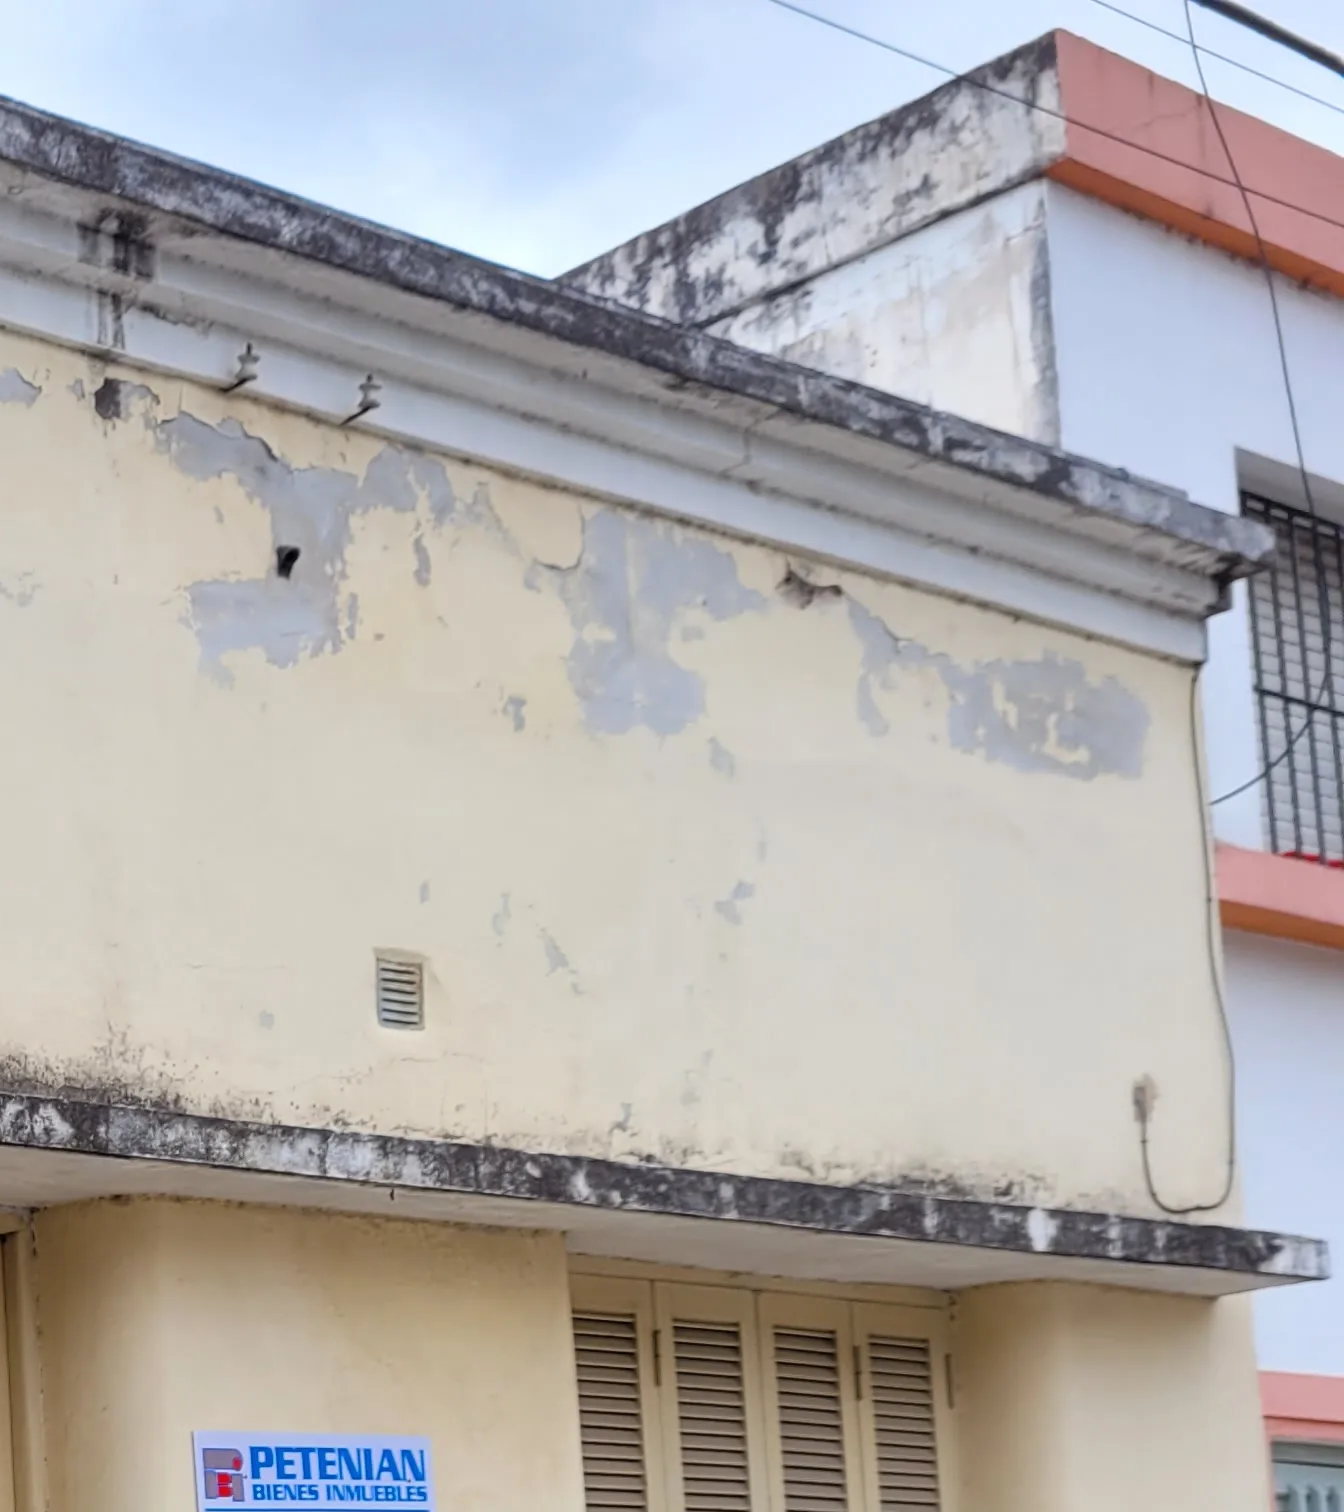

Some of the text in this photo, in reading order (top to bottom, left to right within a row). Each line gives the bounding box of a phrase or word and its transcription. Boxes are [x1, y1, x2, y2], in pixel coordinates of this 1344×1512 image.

[248, 1446, 426, 1482] PETENIAN
[252, 1484, 428, 1502] BIENES INMUEBLES
